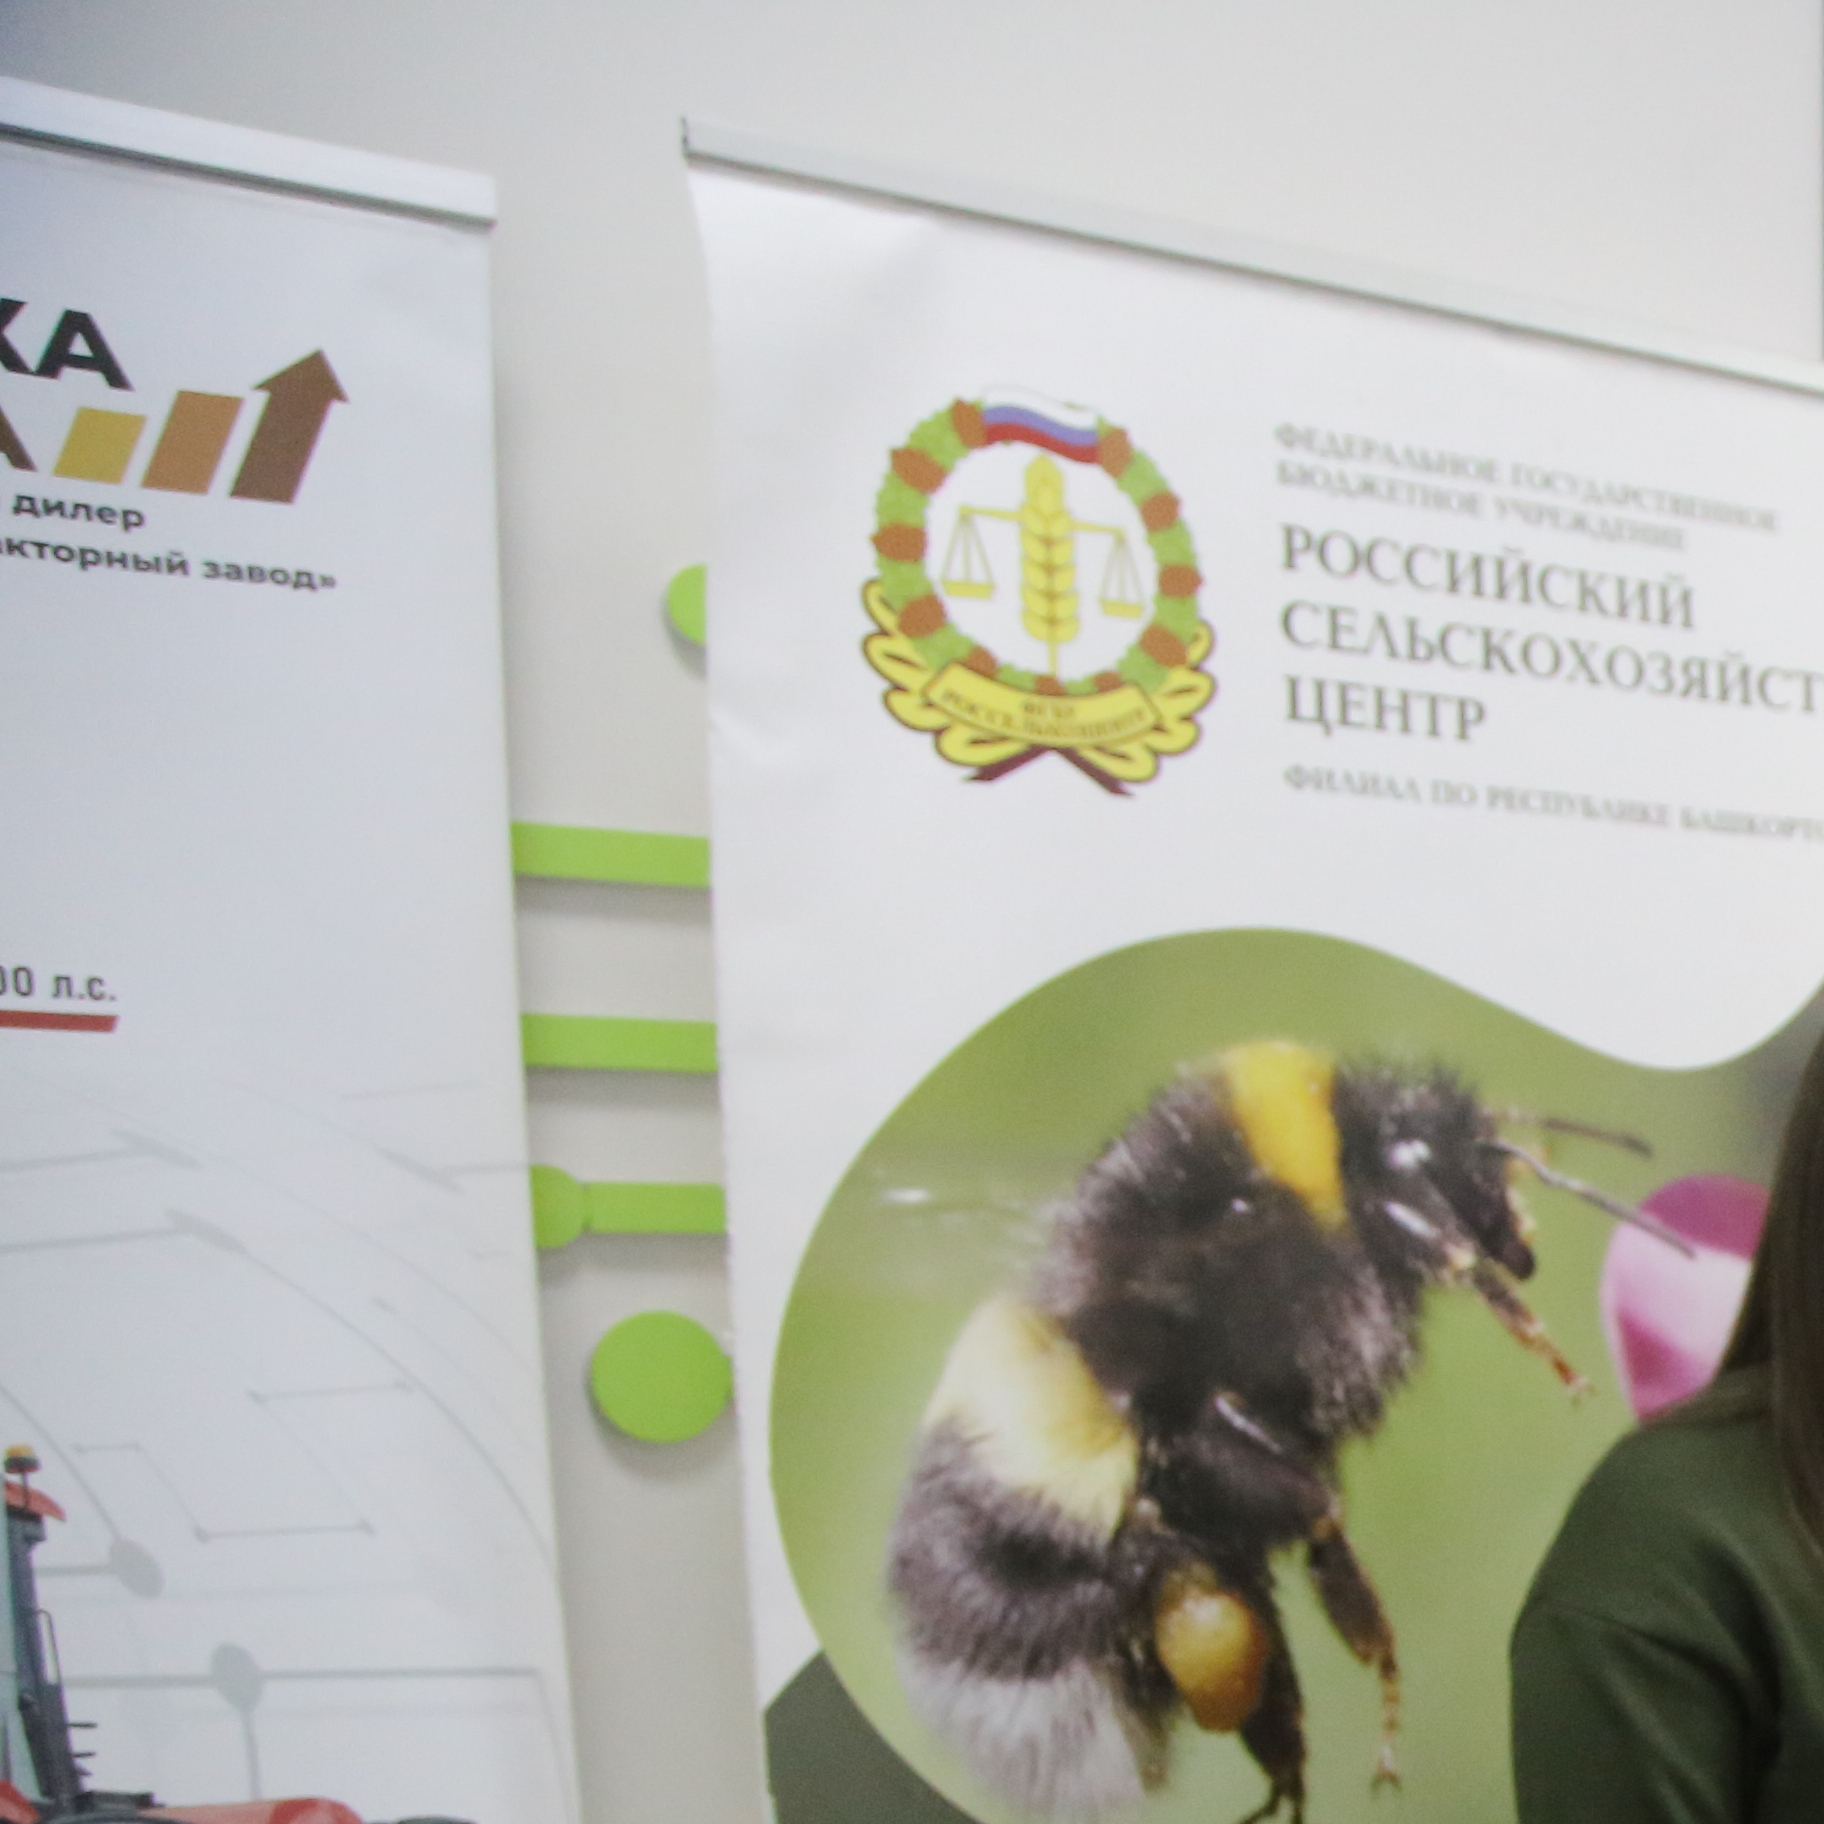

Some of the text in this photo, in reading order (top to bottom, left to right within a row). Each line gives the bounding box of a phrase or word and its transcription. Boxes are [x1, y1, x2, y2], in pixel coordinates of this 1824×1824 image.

[13, 494, 145, 531] дилер
[202, 559, 337, 591] завод»
[1281, 522, 1694, 630] РОССИЙСКИЙ
[1285, 674, 1486, 742] ЦЕНТР
[1283, 762, 1422, 804] ФИЛИАЛ
[1431, 779, 1477, 809] ПО
[52, 975, 117, 1001] л.с.
